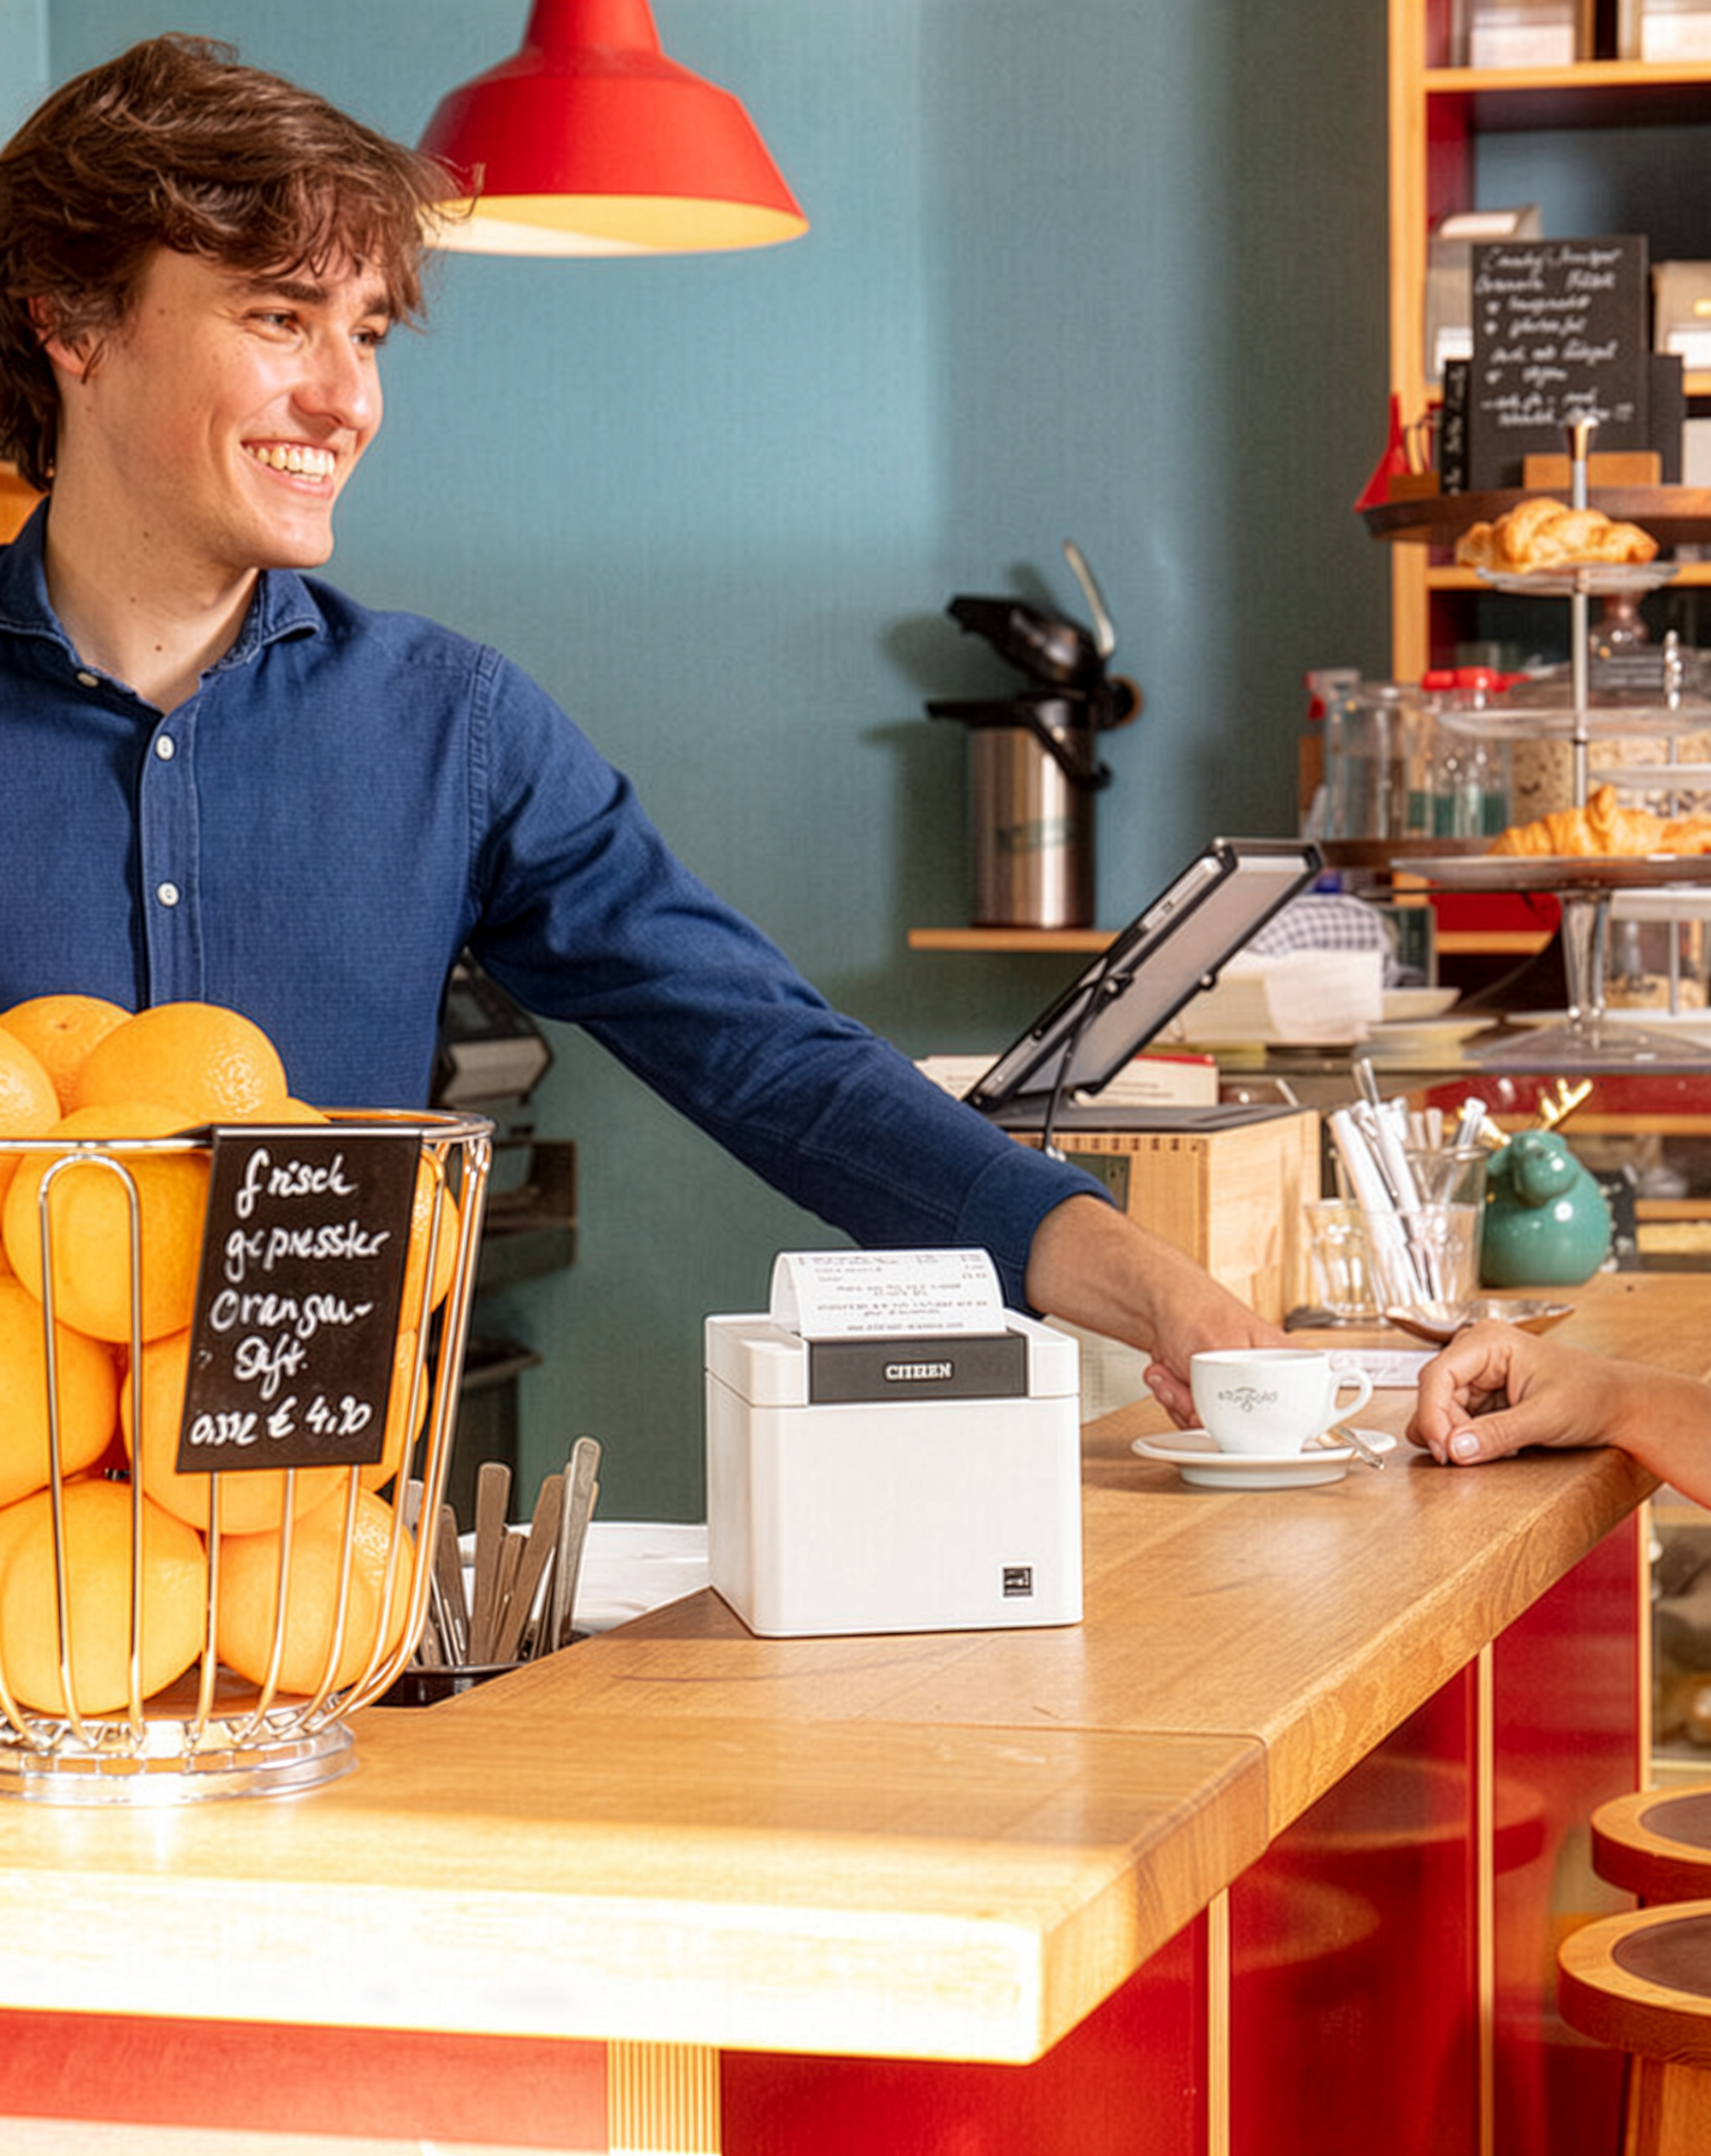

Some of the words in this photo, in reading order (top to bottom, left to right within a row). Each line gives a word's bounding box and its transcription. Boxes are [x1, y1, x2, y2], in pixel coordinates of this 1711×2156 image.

[235, 1147, 358, 1219] frisch
[224, 1219, 392, 1283] gepresster
[885, 1361, 953, 1381] CITIZEN
[265, 1395, 298, 1439] €
